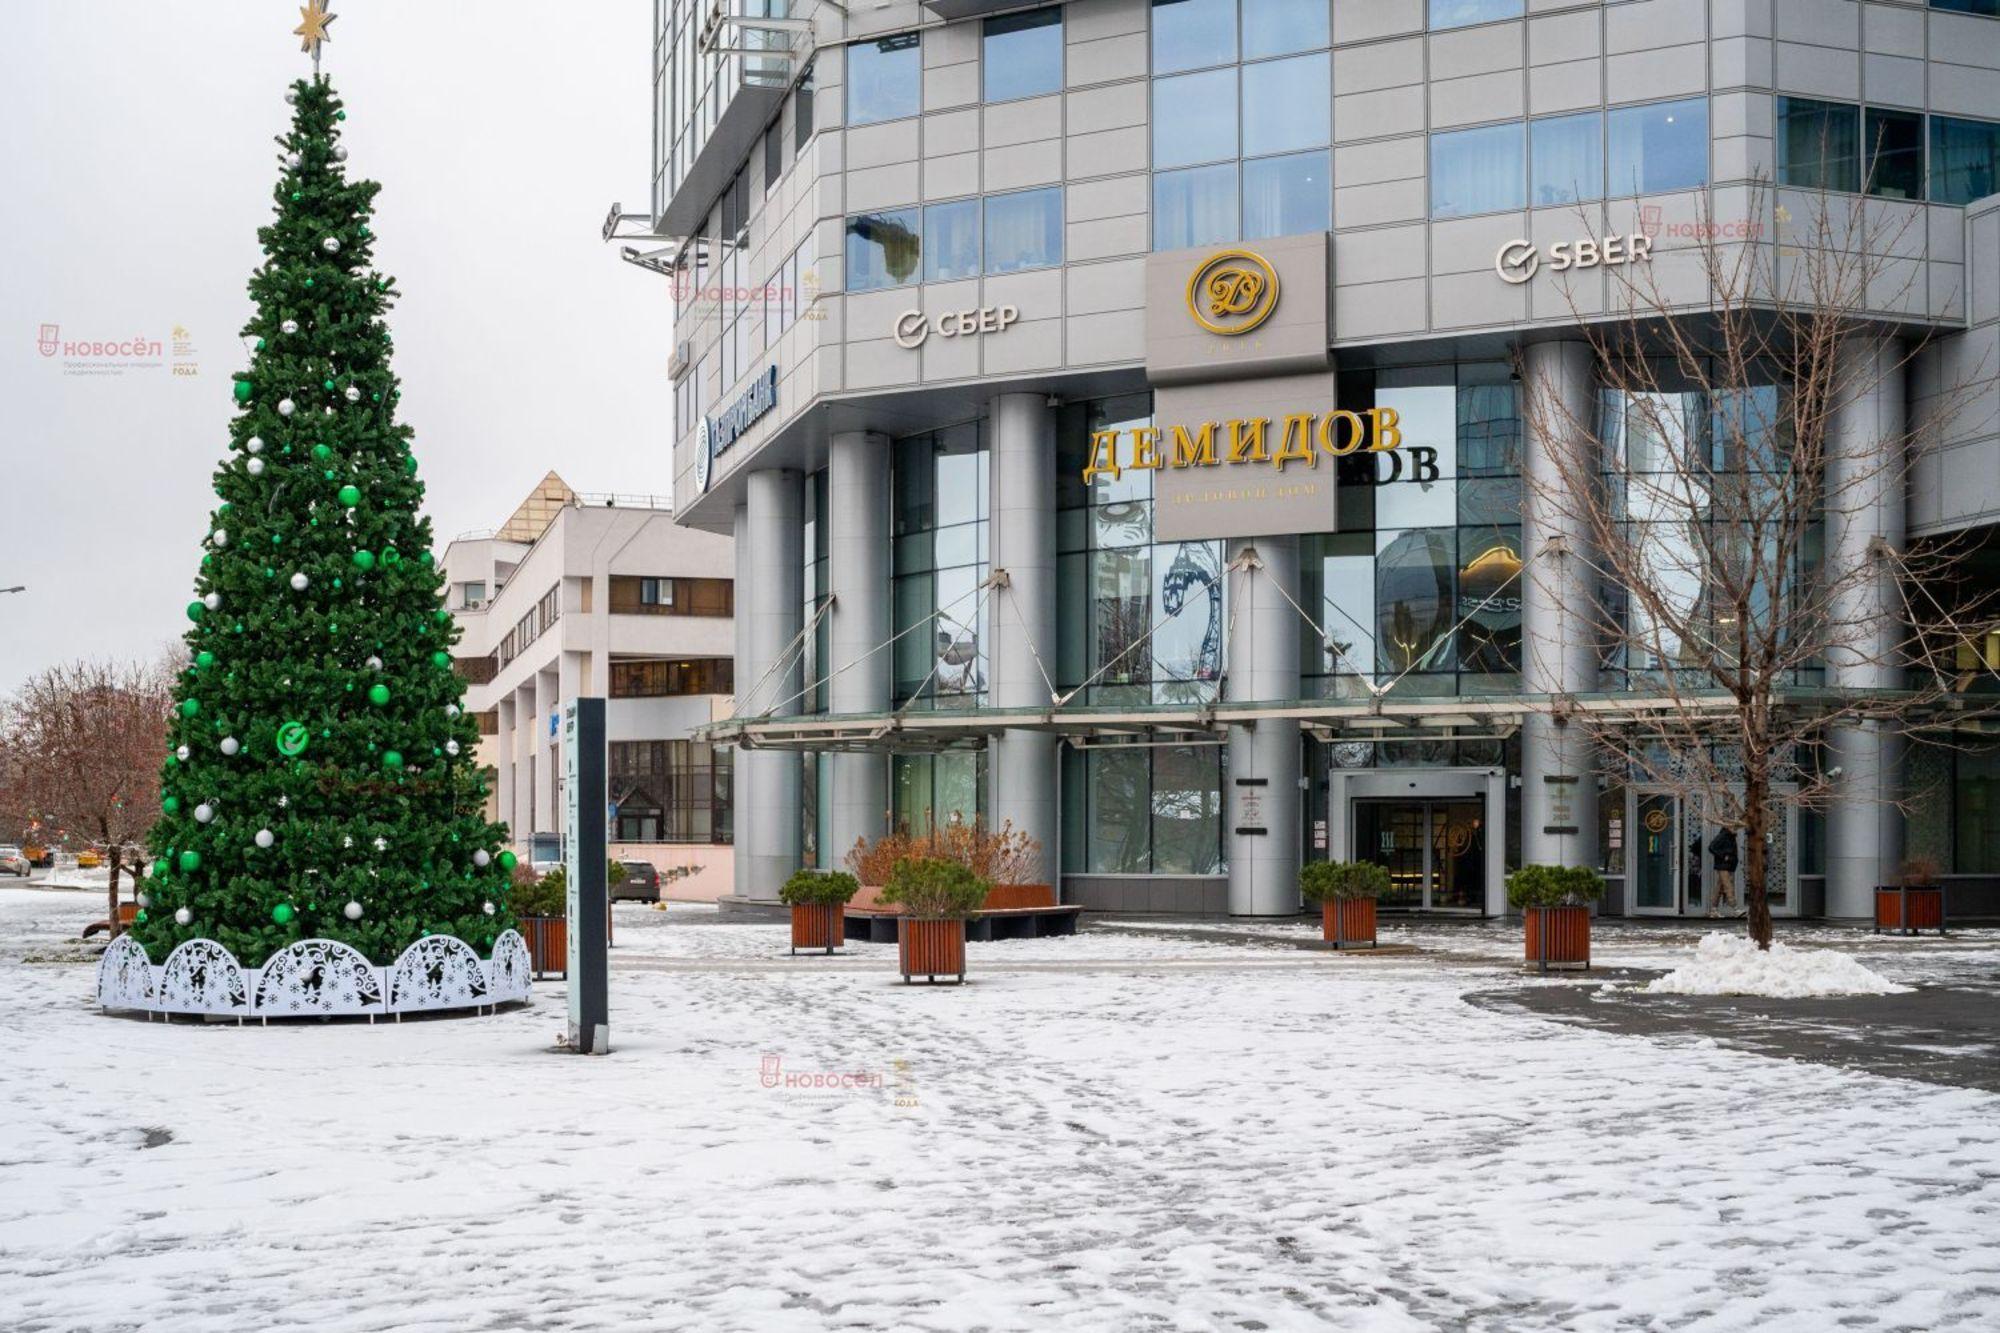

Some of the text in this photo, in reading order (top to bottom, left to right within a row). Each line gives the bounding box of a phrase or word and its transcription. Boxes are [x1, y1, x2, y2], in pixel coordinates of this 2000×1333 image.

[1549, 233, 1653, 272] SBER
[937, 303, 1020, 338] СБЕР
[1082, 407, 1403, 486] ДЕМИДОВ
